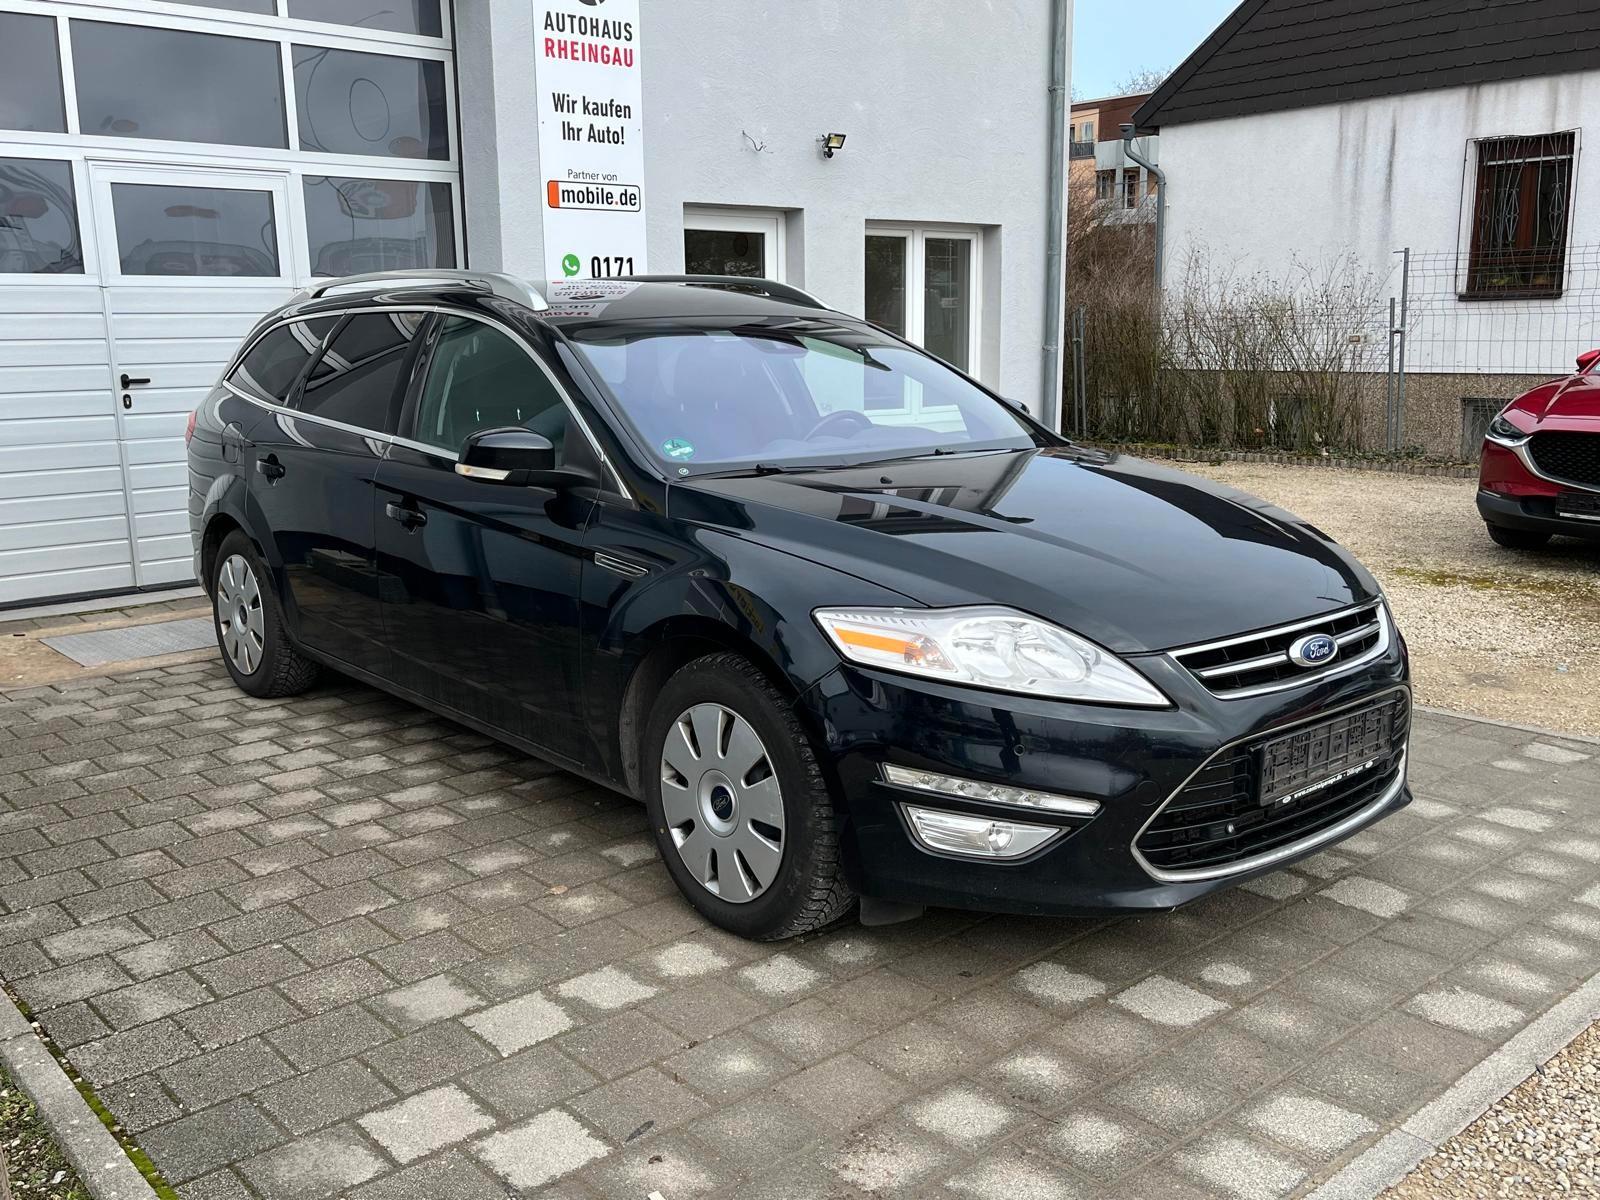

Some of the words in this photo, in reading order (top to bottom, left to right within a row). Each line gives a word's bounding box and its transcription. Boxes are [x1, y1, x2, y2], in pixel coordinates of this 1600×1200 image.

[544, 11, 632, 41] AUTOHAUS
[545, 37, 633, 67] RHEINGAU
[552, 92, 577, 114] Wir
[582, 95, 631, 119] kaufen
[562, 121, 582, 141] Ihr
[588, 123, 624, 145] Auto!
[567, 169, 599, 181] Partner
[602, 173, 618, 182] von
[562, 187, 637, 206] mobile.de
[591, 256, 634, 278] 0171
[1310, 641, 1329, 658] Ford
